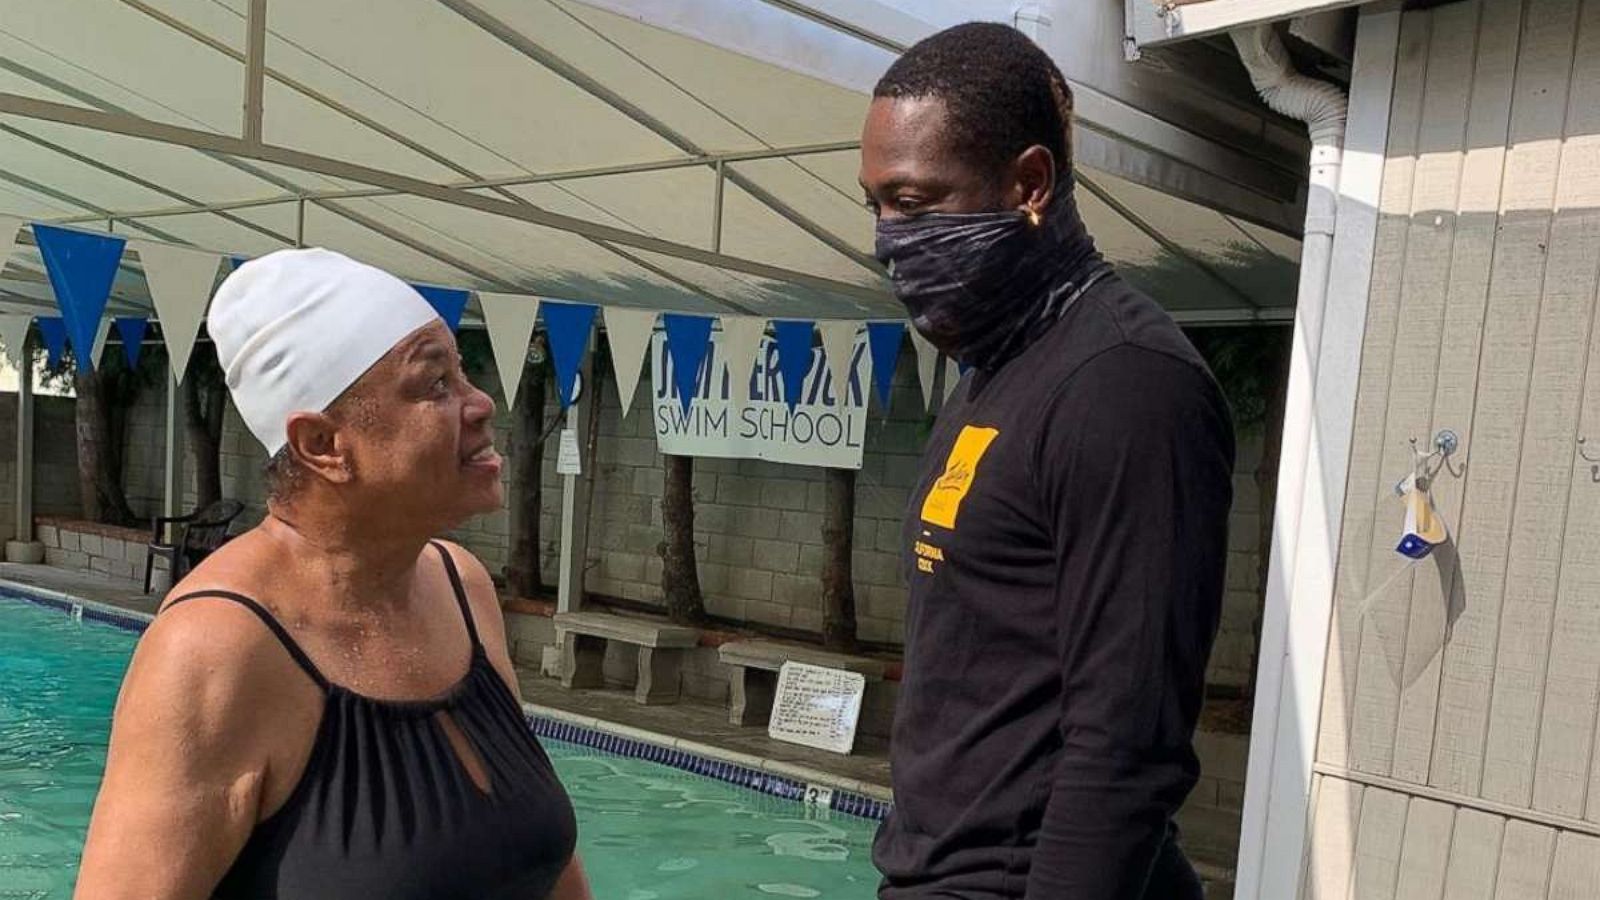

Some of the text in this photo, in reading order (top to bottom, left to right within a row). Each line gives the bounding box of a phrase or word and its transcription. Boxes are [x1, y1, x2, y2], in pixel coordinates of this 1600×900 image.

[657, 340, 715, 400] JM
[658, 405, 861, 447] SWIM SCHOOL
